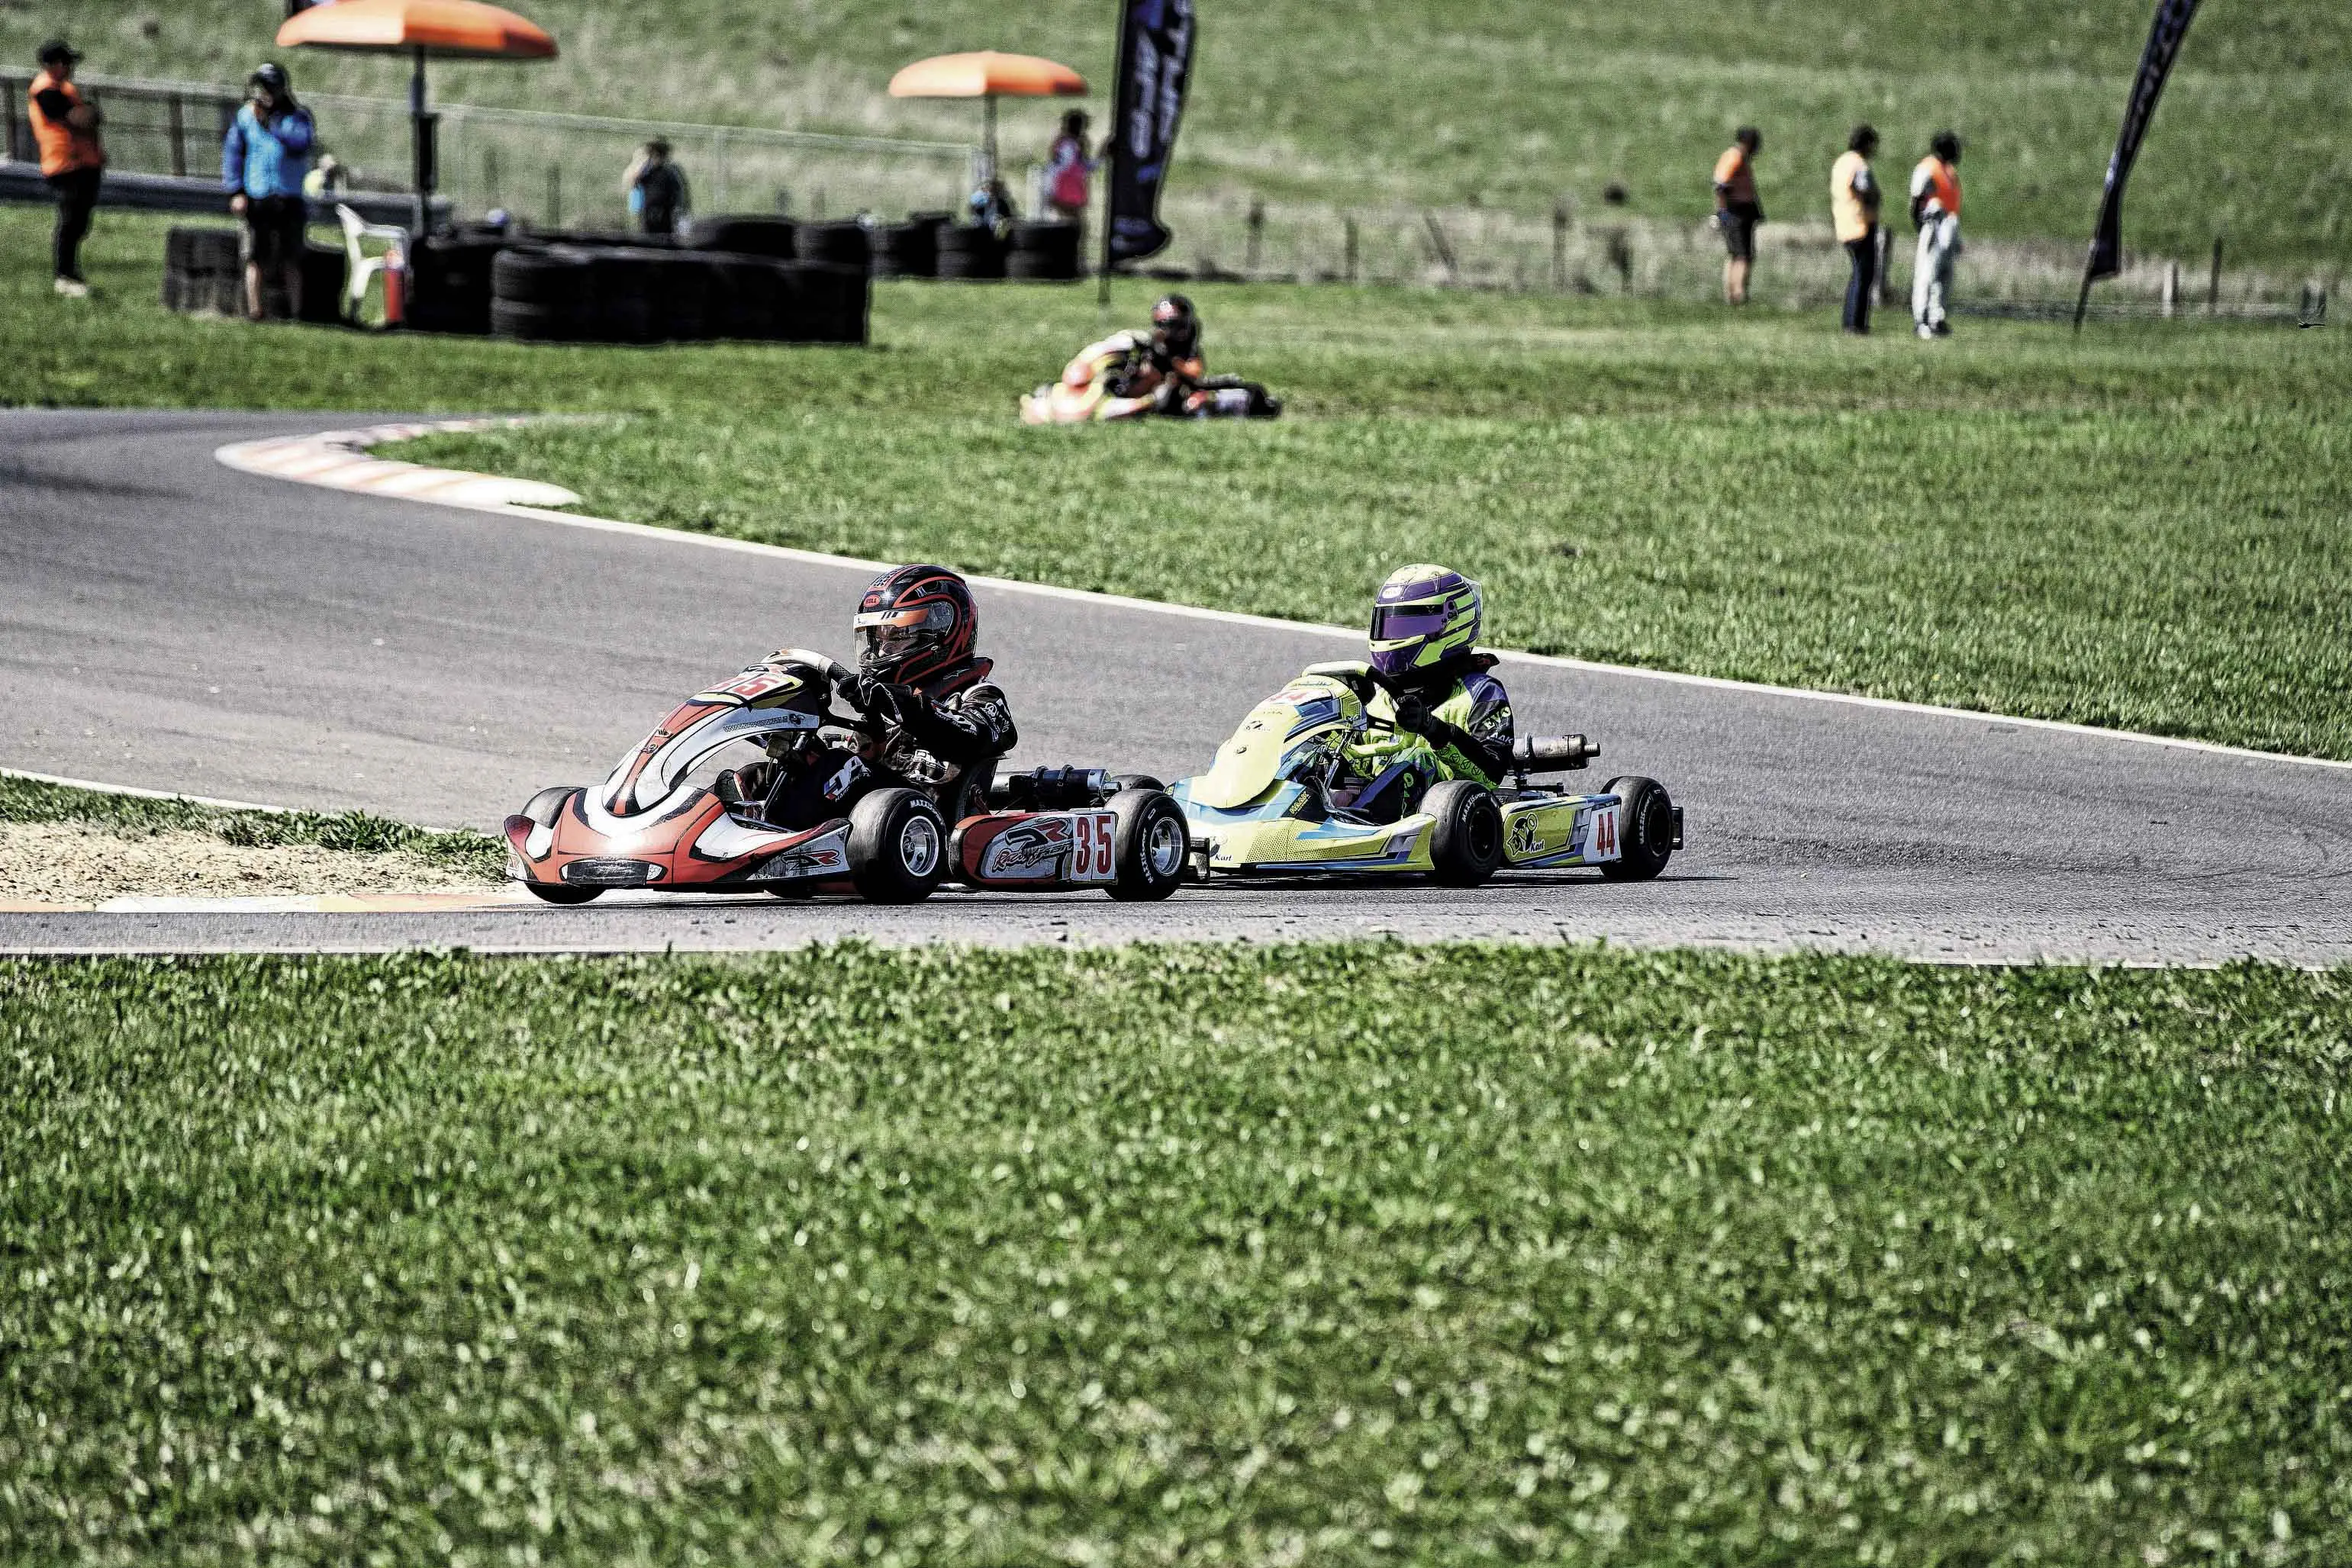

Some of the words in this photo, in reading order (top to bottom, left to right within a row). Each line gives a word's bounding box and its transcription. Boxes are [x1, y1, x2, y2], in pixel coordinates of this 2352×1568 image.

[1486, 732, 1514, 744] AAK
[1289, 790, 1310, 813] HAAK
[1075, 816, 1112, 874] 35
[1506, 812, 1538, 857] EVO
[1529, 839, 1545, 854] Kart
[1596, 811, 1616, 857] 44
[1214, 853, 1233, 861] Kart
